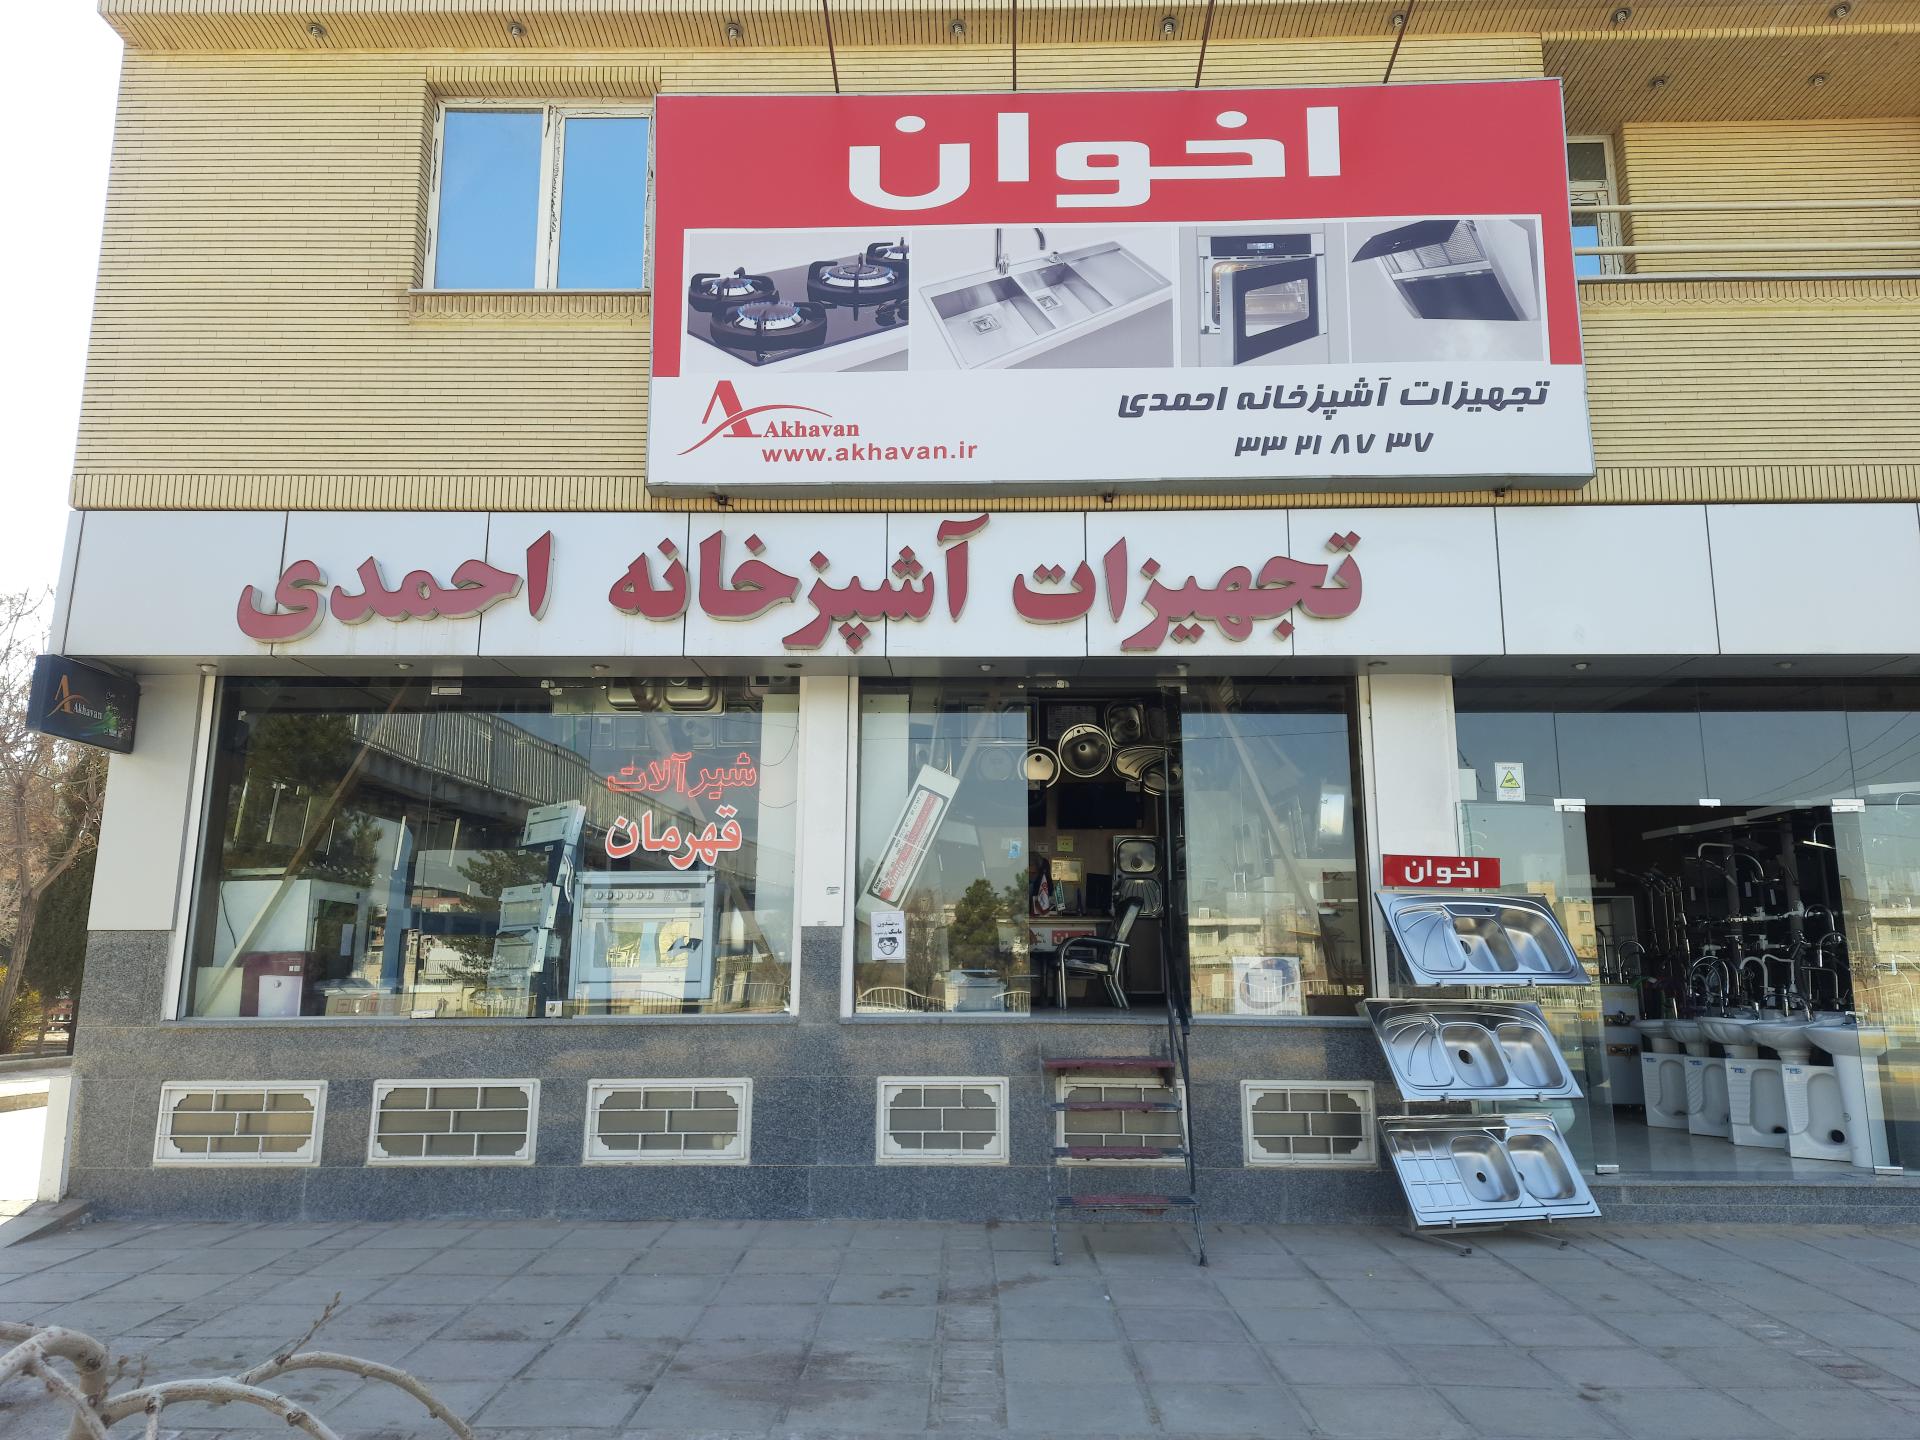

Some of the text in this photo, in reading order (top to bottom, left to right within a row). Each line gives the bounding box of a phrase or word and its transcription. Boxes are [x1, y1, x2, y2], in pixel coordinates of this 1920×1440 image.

[848, 106, 1341, 210] اخوان
[1118, 376, 1551, 420] تجهیزات آشپزخانه احمدی
[763, 421, 859, 438] Akhavan
[1234, 432, 1434, 457] ۳۳ ۲۱ ۸۷ ۳۷
[762, 441, 978, 462] www.akhavan.ir
[237, 513, 1362, 652] تجهیزات آشپزخانه احمدی
[73, 702, 103, 720] Akhavan
[608, 752, 757, 799] شیر آلات
[605, 804, 742, 870] قهرمان
[1405, 859, 1479, 884] اخوان
